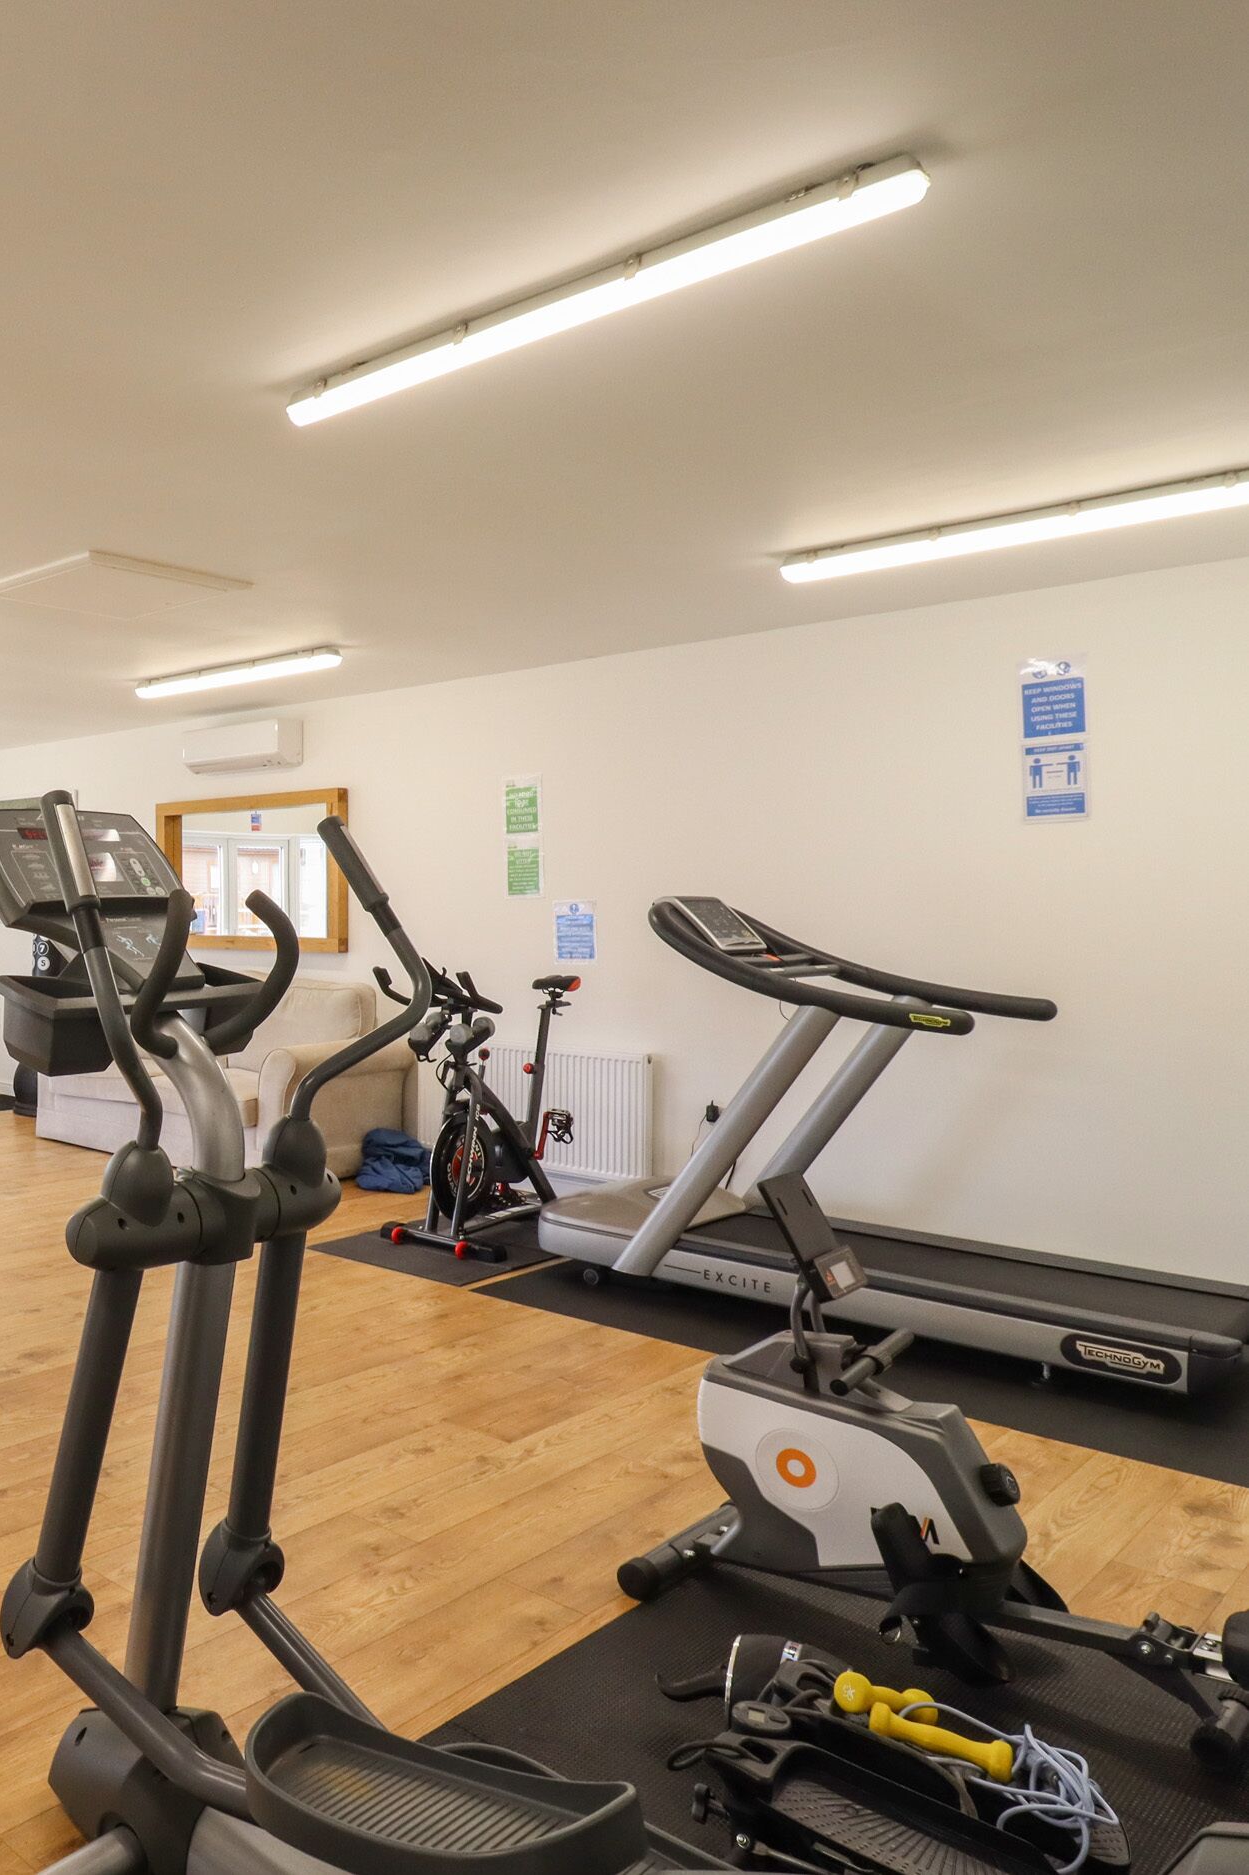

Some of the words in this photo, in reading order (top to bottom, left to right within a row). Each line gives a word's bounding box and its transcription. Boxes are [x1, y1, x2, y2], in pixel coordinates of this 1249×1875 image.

[1042, 683, 1082, 692] WINDOWS
[1049, 693, 1075, 701] DOORS
[1031, 705, 1051, 713] OPEN
[1052, 702, 1077, 710] WHEN
[1031, 714, 1054, 722] USING
[1054, 711, 1077, 719] THESE
[1035, 721, 1073, 730] FACILITIES
[703, 1269, 771, 1293] EXCITE
